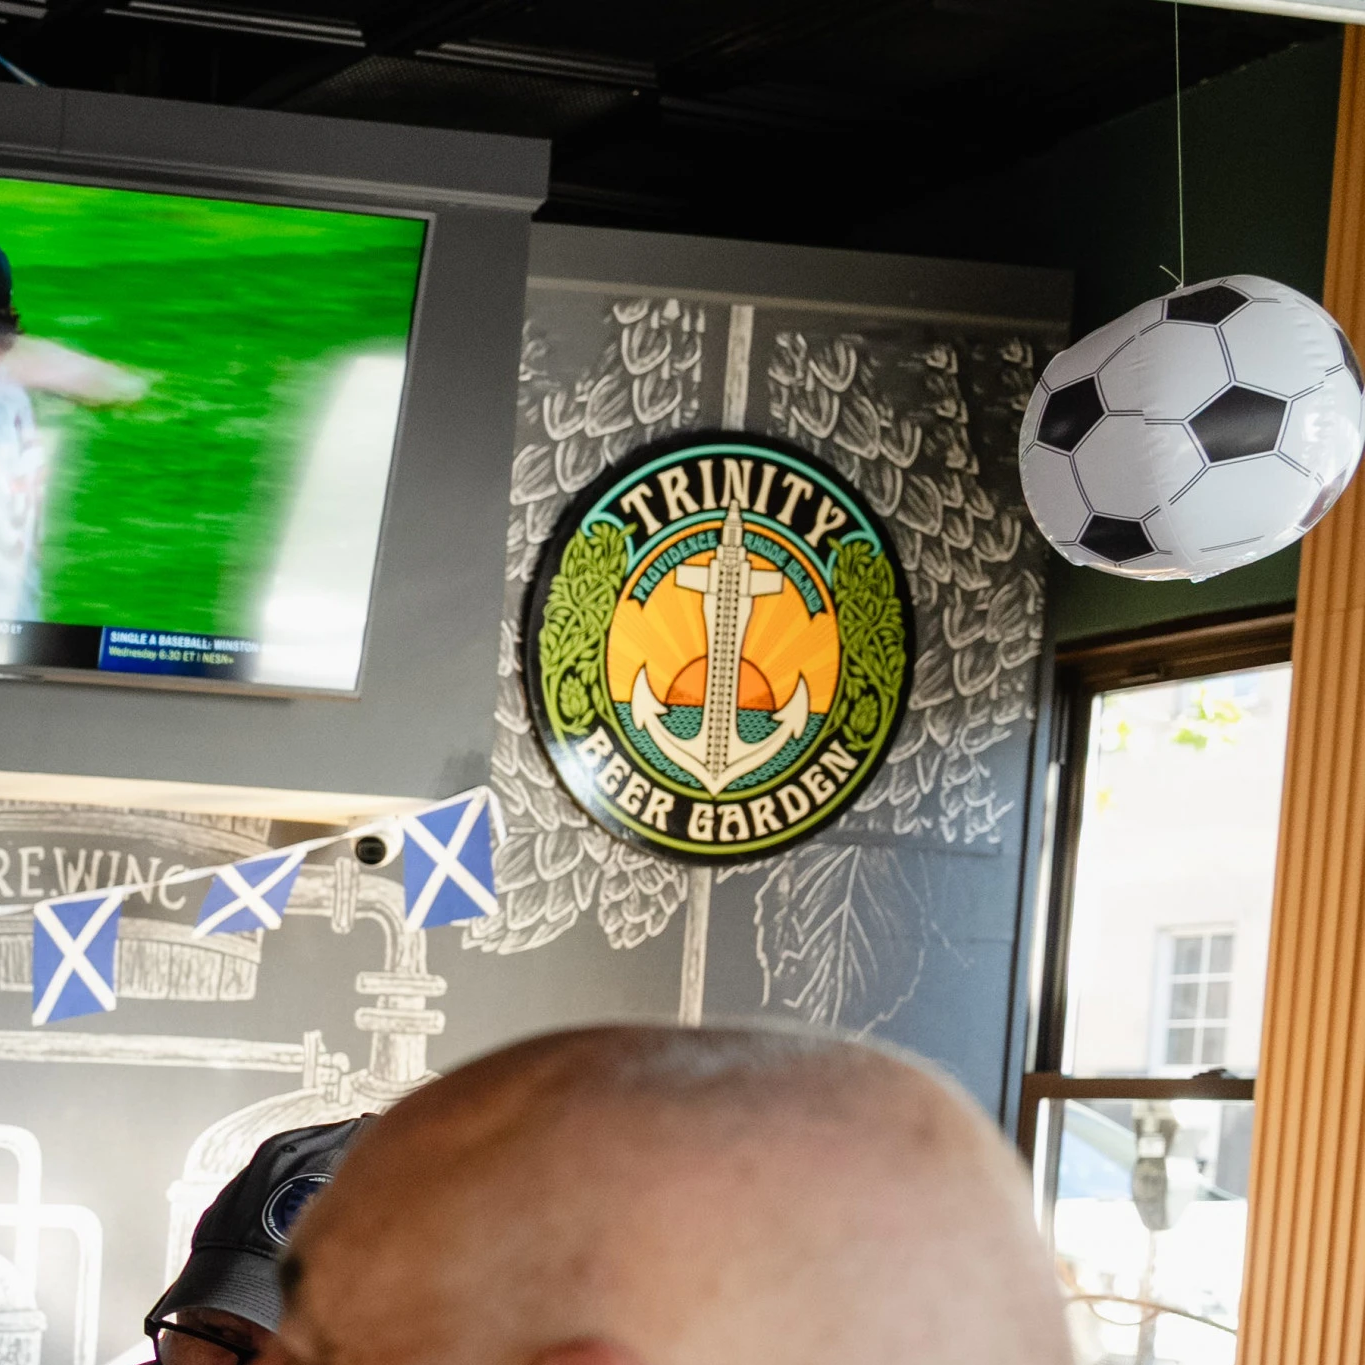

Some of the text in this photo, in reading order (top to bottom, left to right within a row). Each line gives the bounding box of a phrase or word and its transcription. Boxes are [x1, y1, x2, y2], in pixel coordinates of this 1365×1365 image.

[620, 458, 847, 548] TRINITY
[631, 529, 719, 601] PROVIDENCE
[743, 531, 790, 568] RHODE
[109, 646, 157, 662] Wednesday
[182, 651, 195, 662] ET
[110, 631, 148, 645] SINGLE
[575, 727, 859, 842] BEER GARDEN
